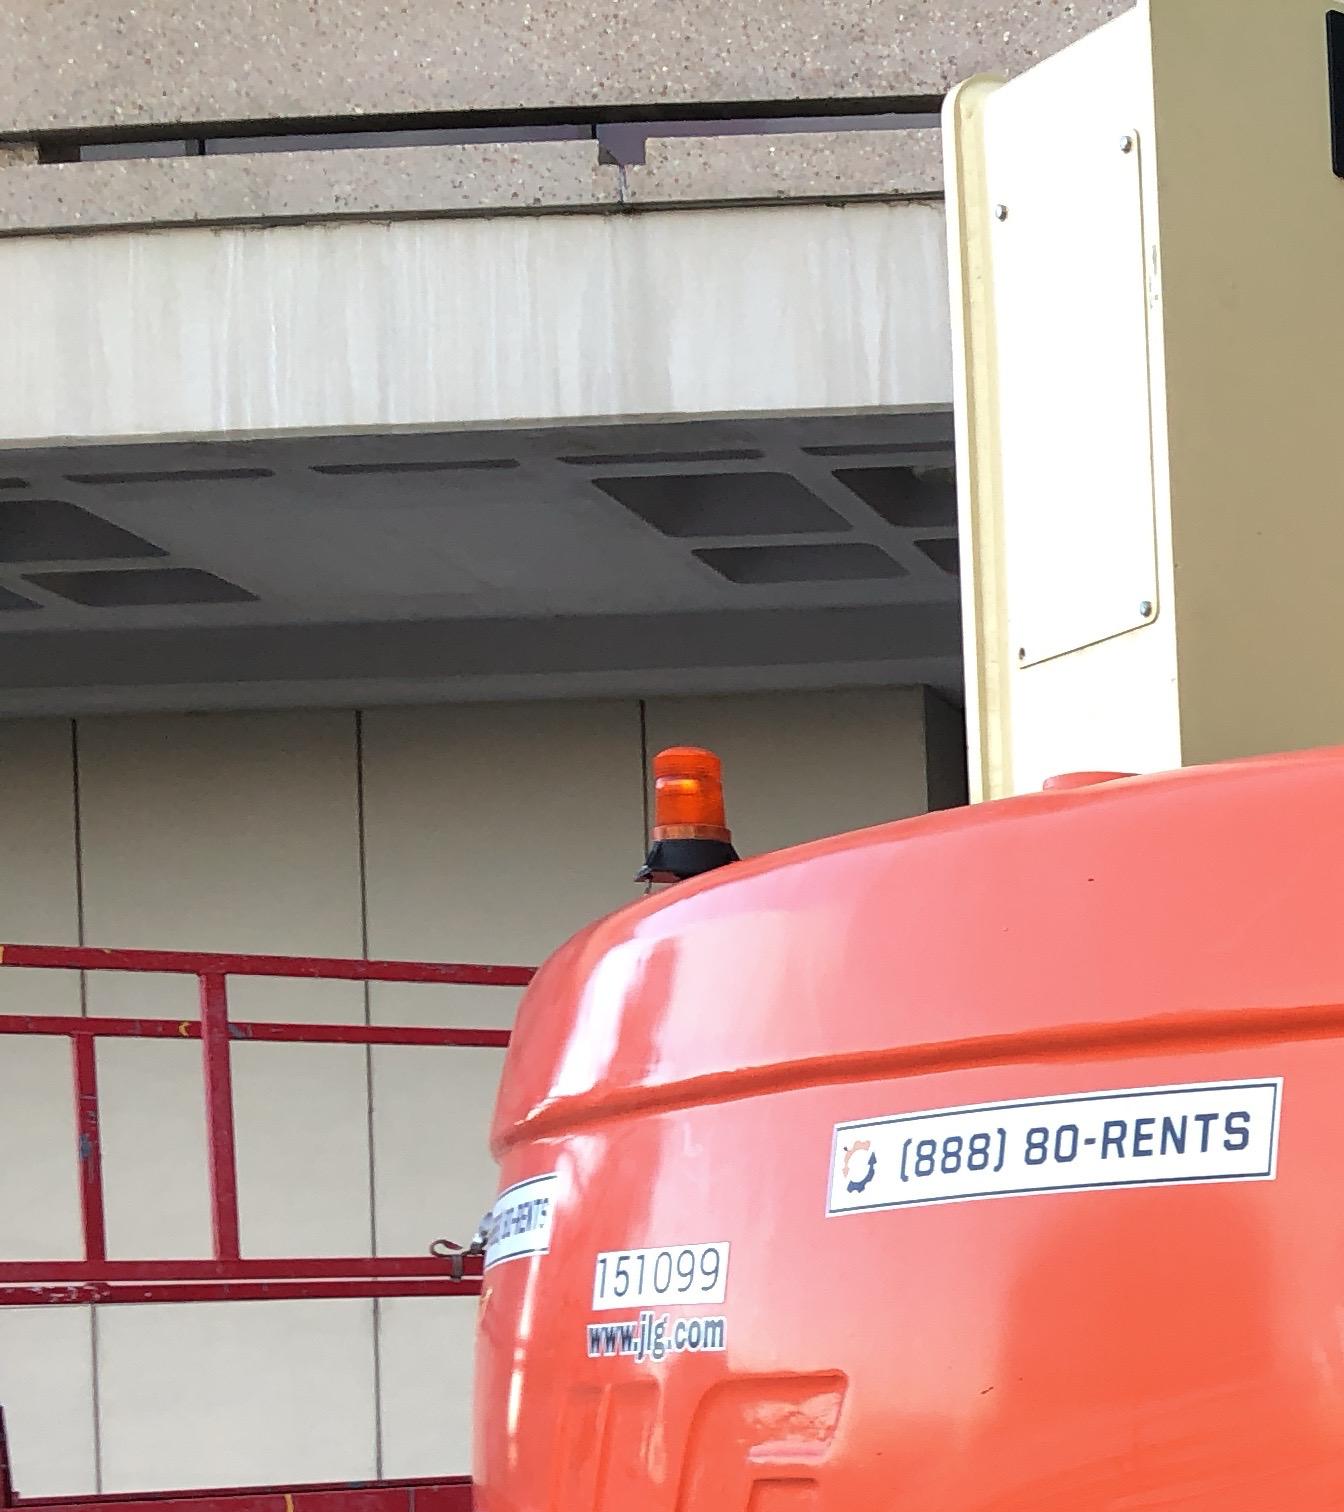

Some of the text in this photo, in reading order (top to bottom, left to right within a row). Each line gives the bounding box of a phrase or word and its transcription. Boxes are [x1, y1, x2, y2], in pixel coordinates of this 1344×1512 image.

[900, 1111, 1251, 1183] (888) 80-RENTS
[597, 1247, 721, 1299] 151099
[588, 1313, 725, 1361] www.jlg.com
